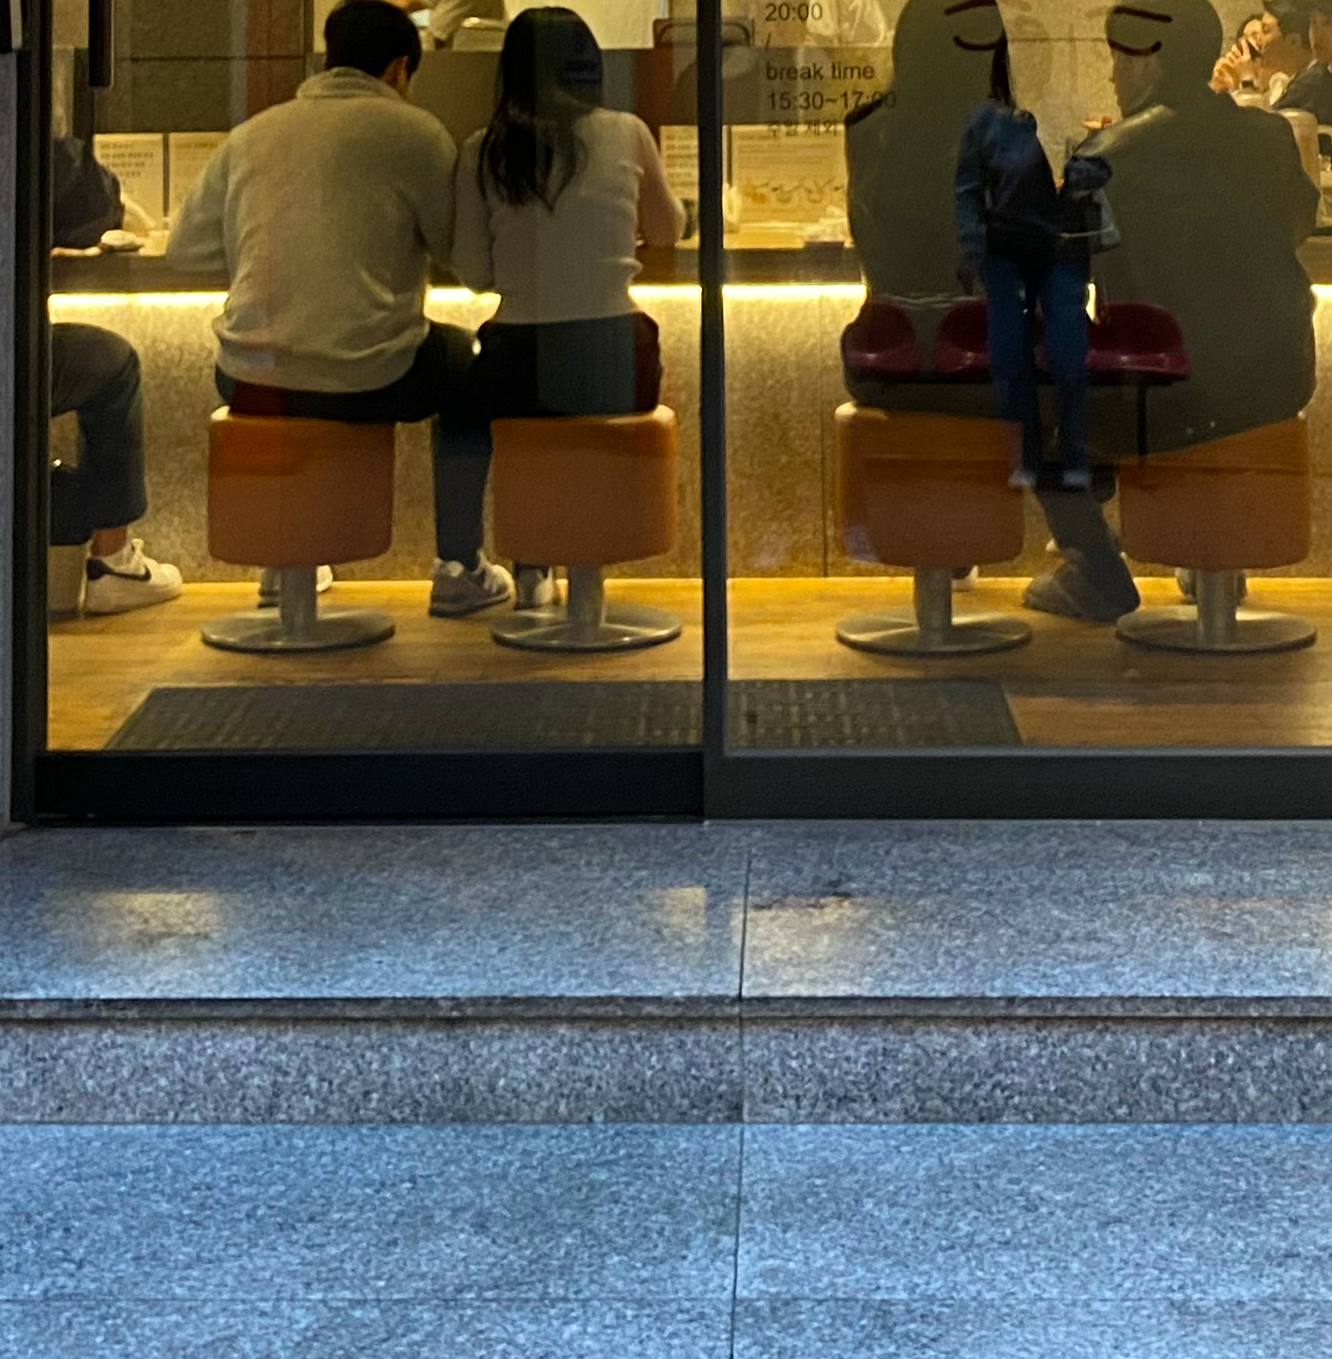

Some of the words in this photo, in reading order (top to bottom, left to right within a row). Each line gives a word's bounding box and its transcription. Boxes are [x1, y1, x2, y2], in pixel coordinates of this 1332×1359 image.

[764, 2, 823, 22] 20:00
[765, 61, 824, 81] break
[830, 61, 875, 80] time
